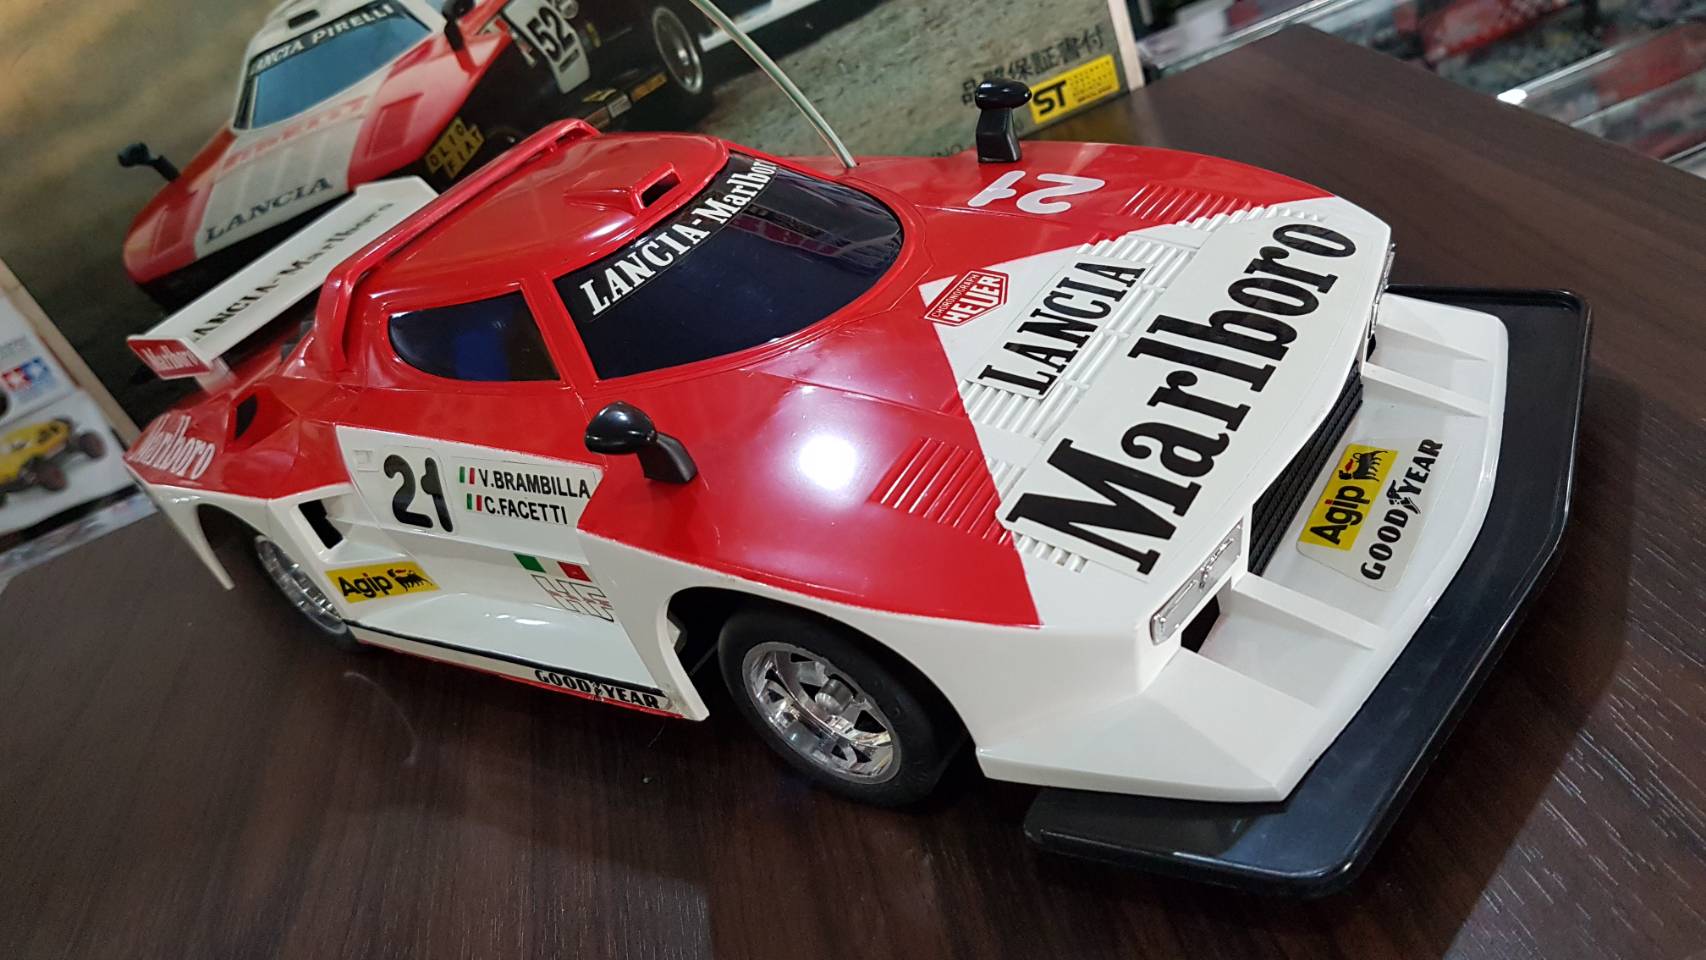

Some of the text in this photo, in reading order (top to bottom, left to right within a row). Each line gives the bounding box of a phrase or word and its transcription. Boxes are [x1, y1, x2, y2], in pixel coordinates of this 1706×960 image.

[312, 4, 394, 45] PIRELLI
[527, 6, 576, 62] 52
[1033, 80, 1067, 116] ST
[205, 177, 334, 244] LANCIA
[967, 170, 1106, 214] 21
[943, 275, 1002, 323] HEUER
[978, 262, 1146, 396] LANCIA
[1006, 223, 1357, 575] Marlboro
[383, 454, 454, 533] 21
[478, 468, 591, 500] V.BRAMBILLA
[484, 496, 568, 525] C.FACETTI
[1310, 485, 1371, 546] Agip
[338, 573, 394, 599] Agip
